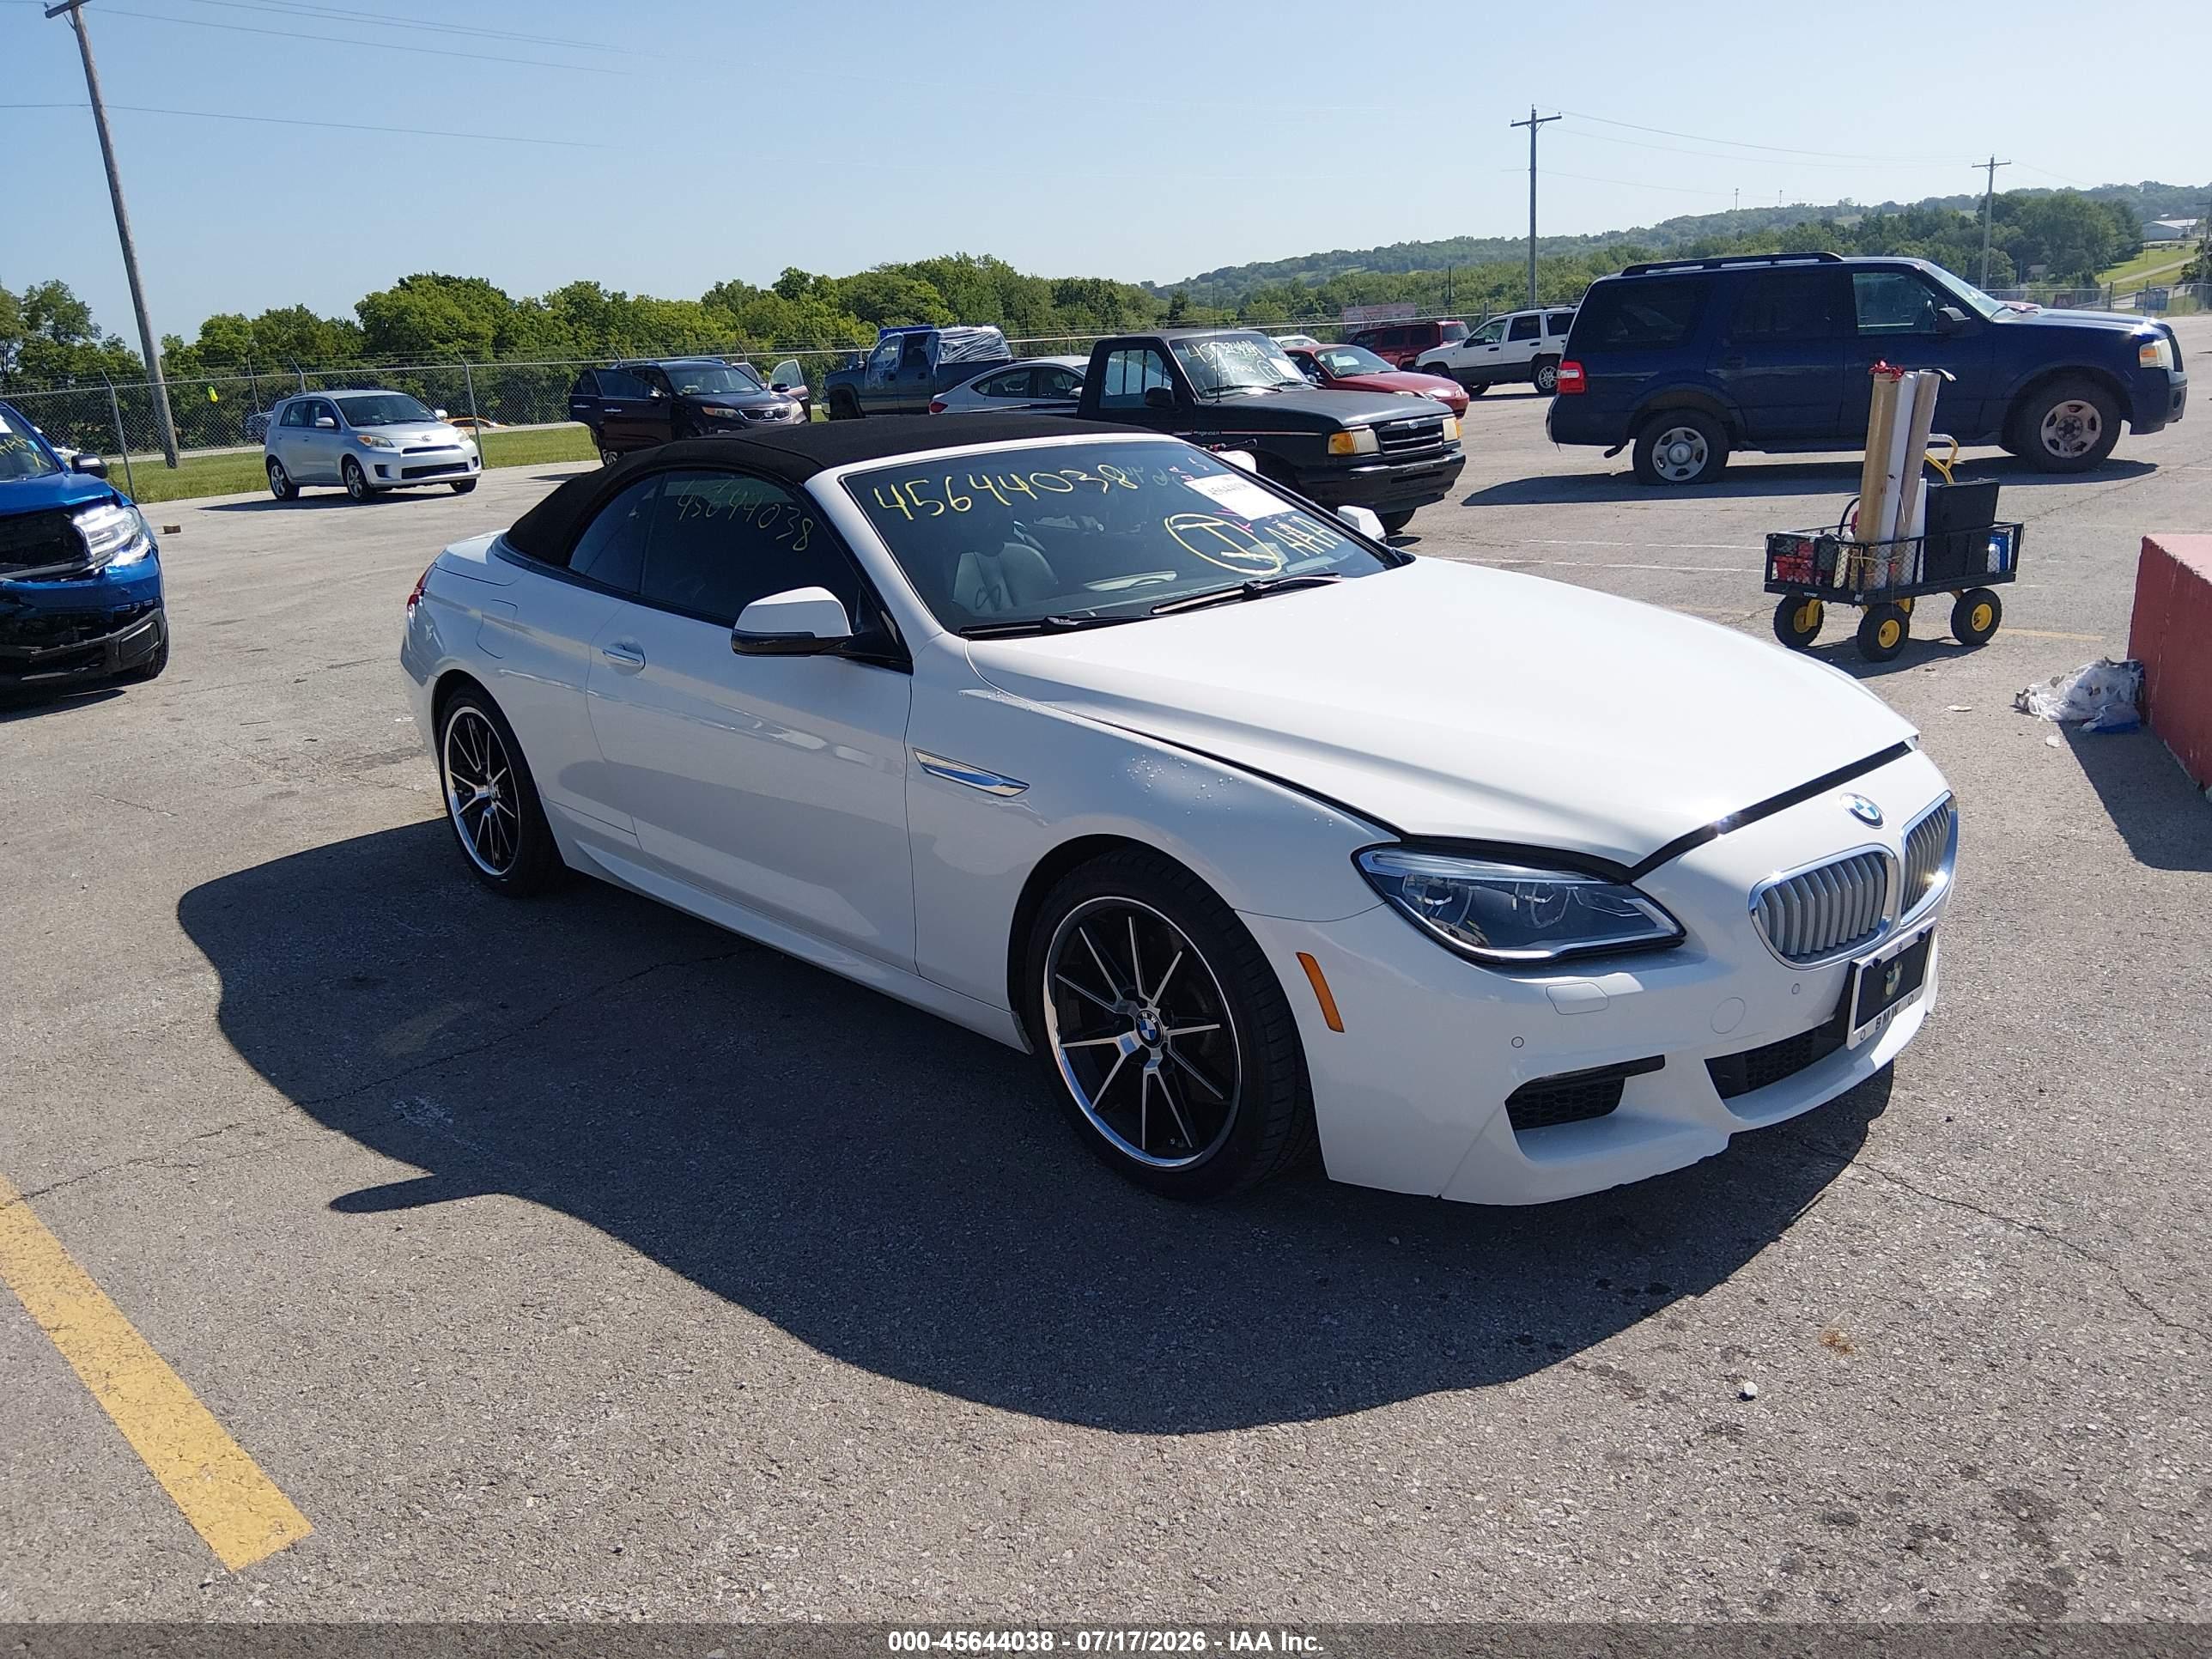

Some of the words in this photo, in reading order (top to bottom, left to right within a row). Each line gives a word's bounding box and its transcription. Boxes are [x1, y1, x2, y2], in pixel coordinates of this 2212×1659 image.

[677, 479, 814, 550] 45644038
[873, 464, 1139, 520] 45644038
[1875, 1003, 1899, 1030] BMW
